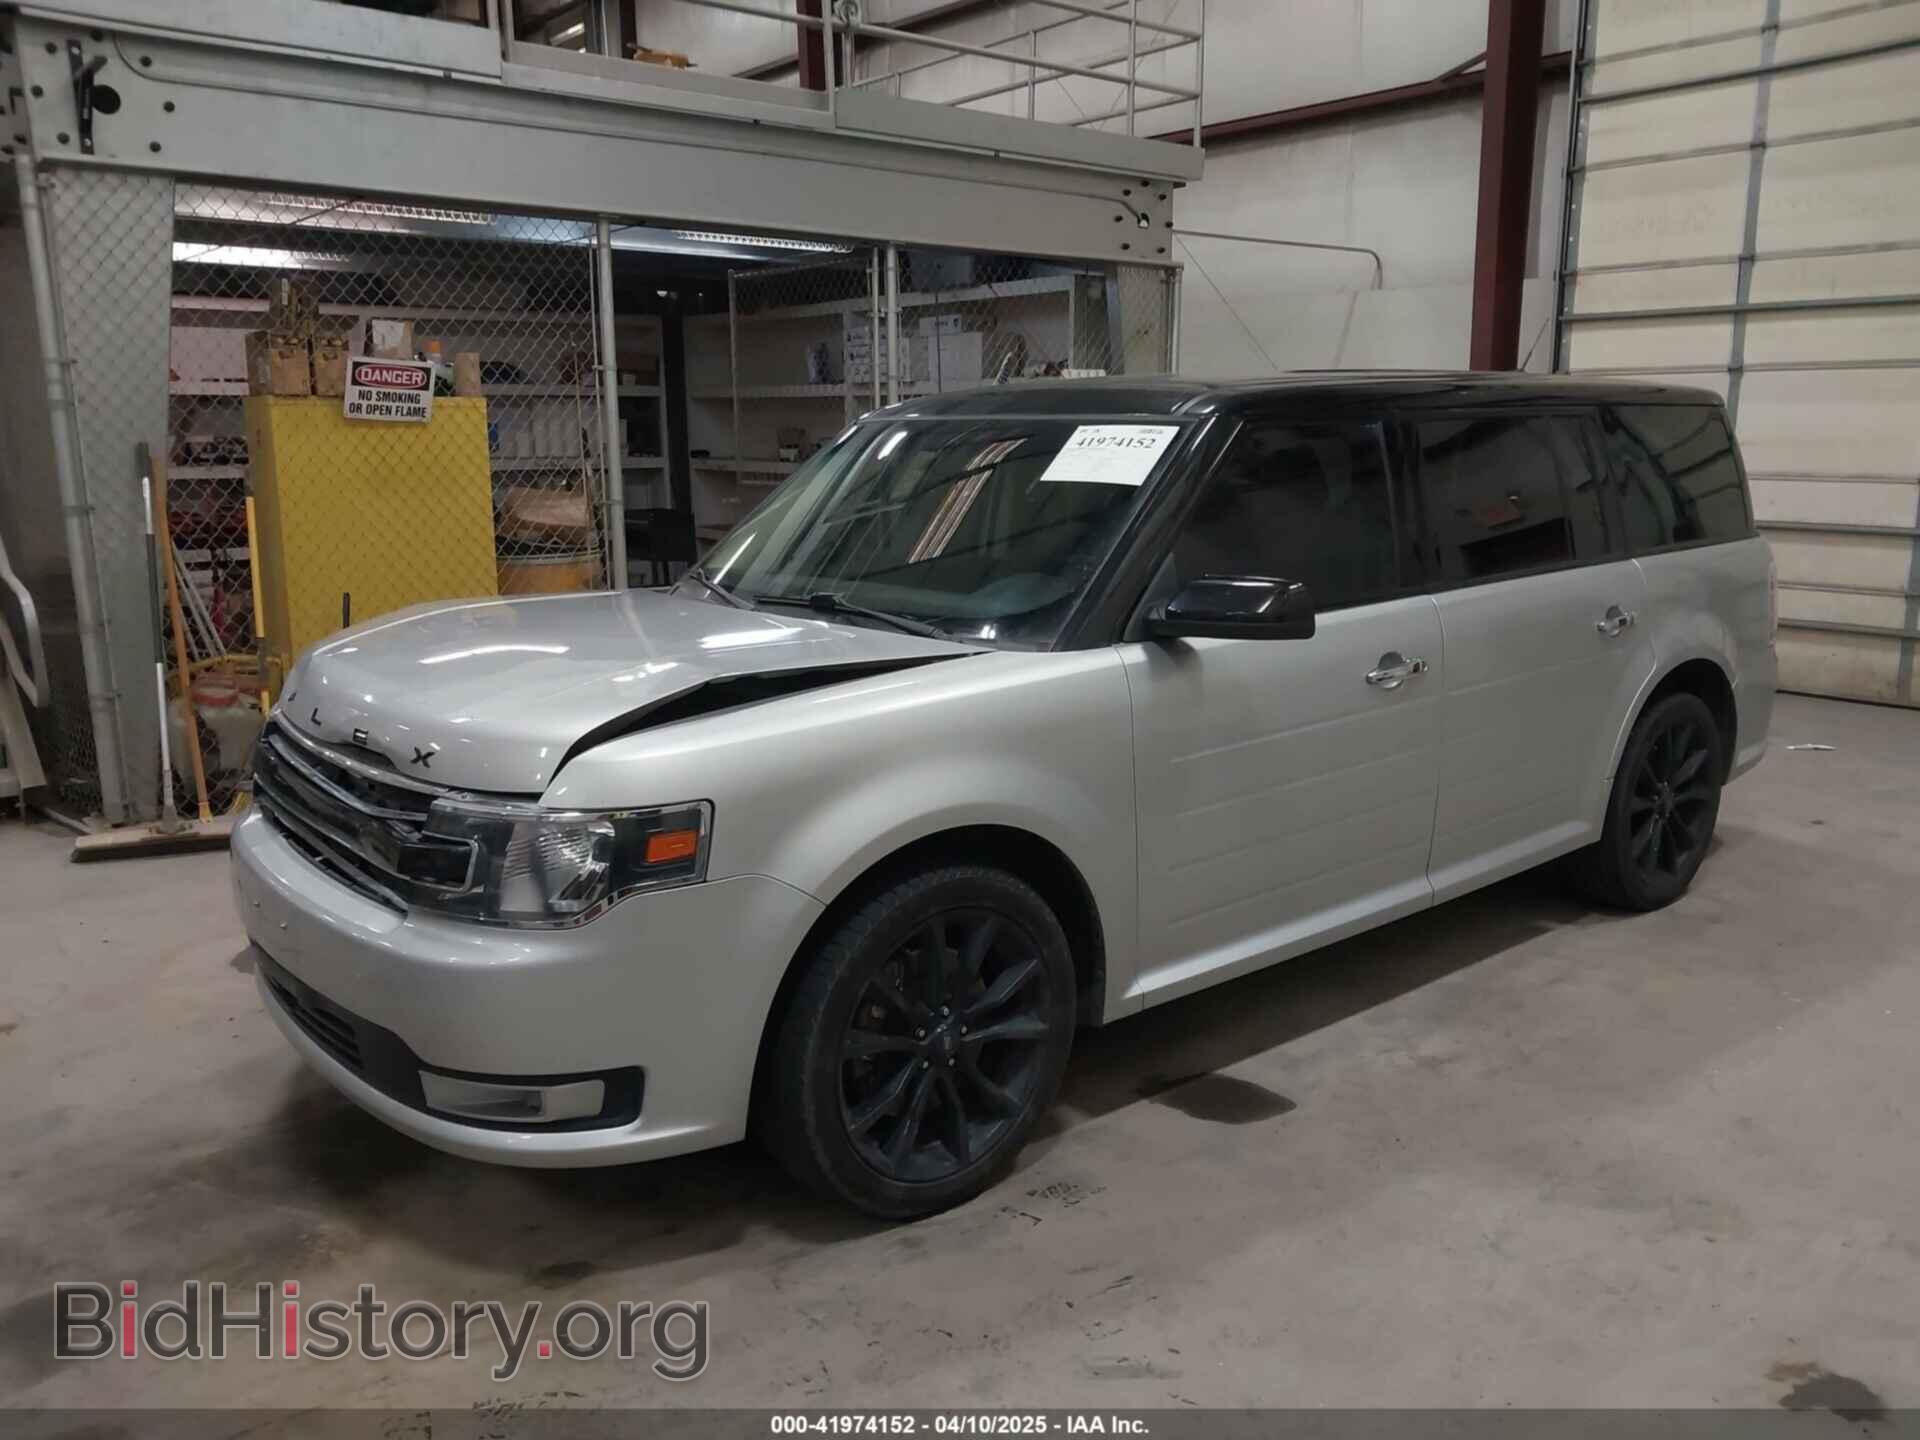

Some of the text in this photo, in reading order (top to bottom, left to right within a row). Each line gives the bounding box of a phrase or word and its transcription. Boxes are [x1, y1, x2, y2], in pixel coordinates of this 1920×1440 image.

[360, 368, 423, 385] DANGER
[358, 389, 421, 404] NO SMOKING
[348, 402, 427, 418] OR OPEN FLAME
